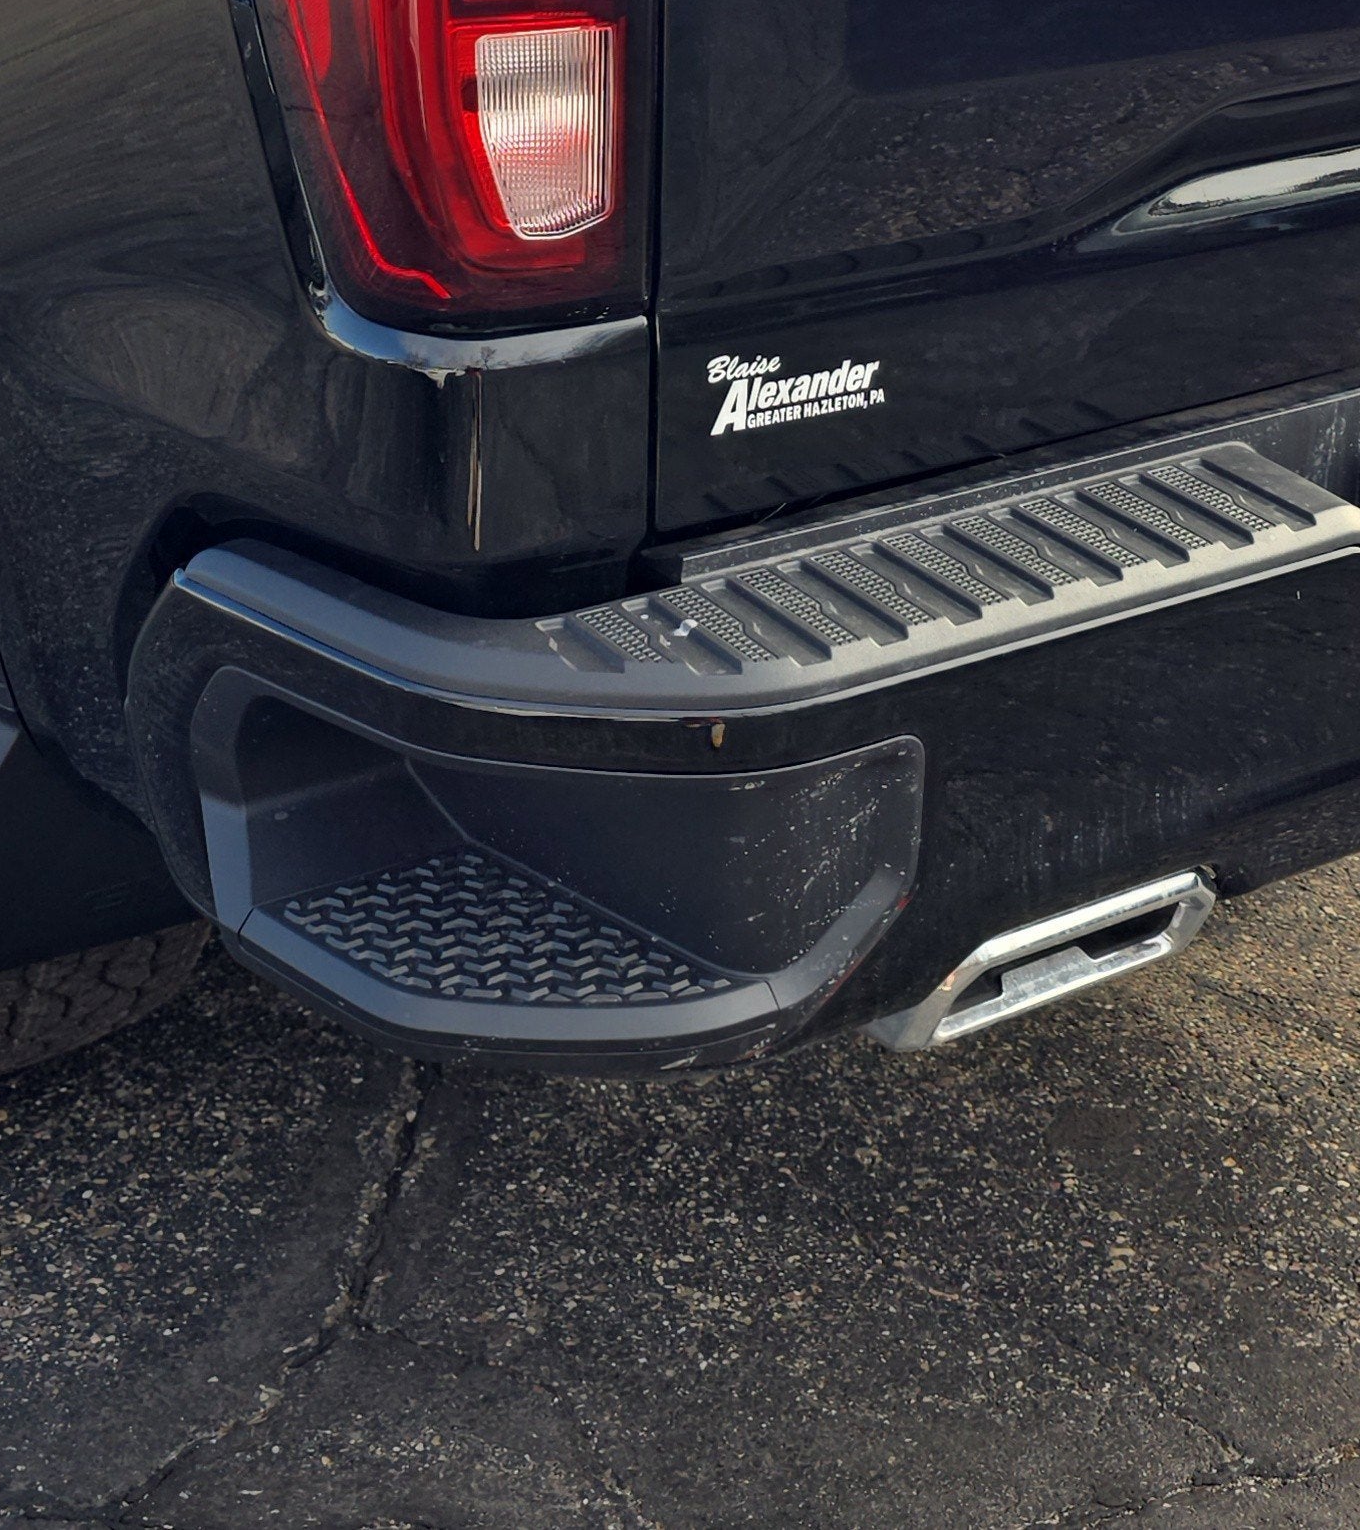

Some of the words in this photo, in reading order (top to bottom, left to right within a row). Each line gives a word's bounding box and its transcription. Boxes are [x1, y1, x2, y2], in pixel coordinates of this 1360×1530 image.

[706, 355, 782, 384] Blaise
[710, 360, 880, 436] Alexander
[747, 405, 802, 429] GREATER
[803, 390, 868, 418] HAZLETON,
[869, 388, 886, 405] PA
